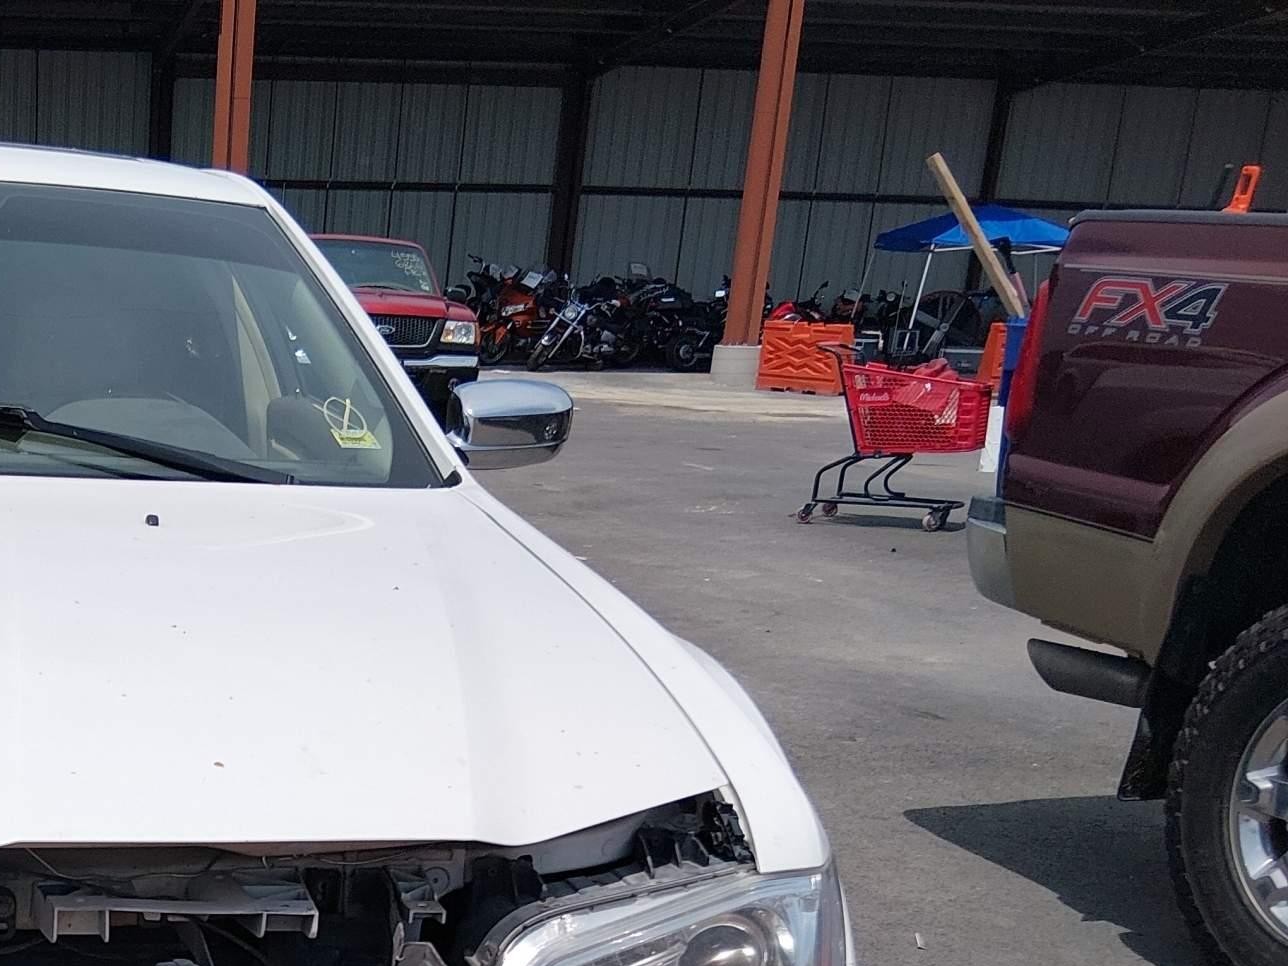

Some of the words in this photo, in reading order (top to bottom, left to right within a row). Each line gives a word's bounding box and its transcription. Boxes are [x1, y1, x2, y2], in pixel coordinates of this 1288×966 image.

[1072, 275, 1229, 335] FX4
[1067, 324, 1117, 337] OFF
[1125, 330, 1202, 347] ROAD
